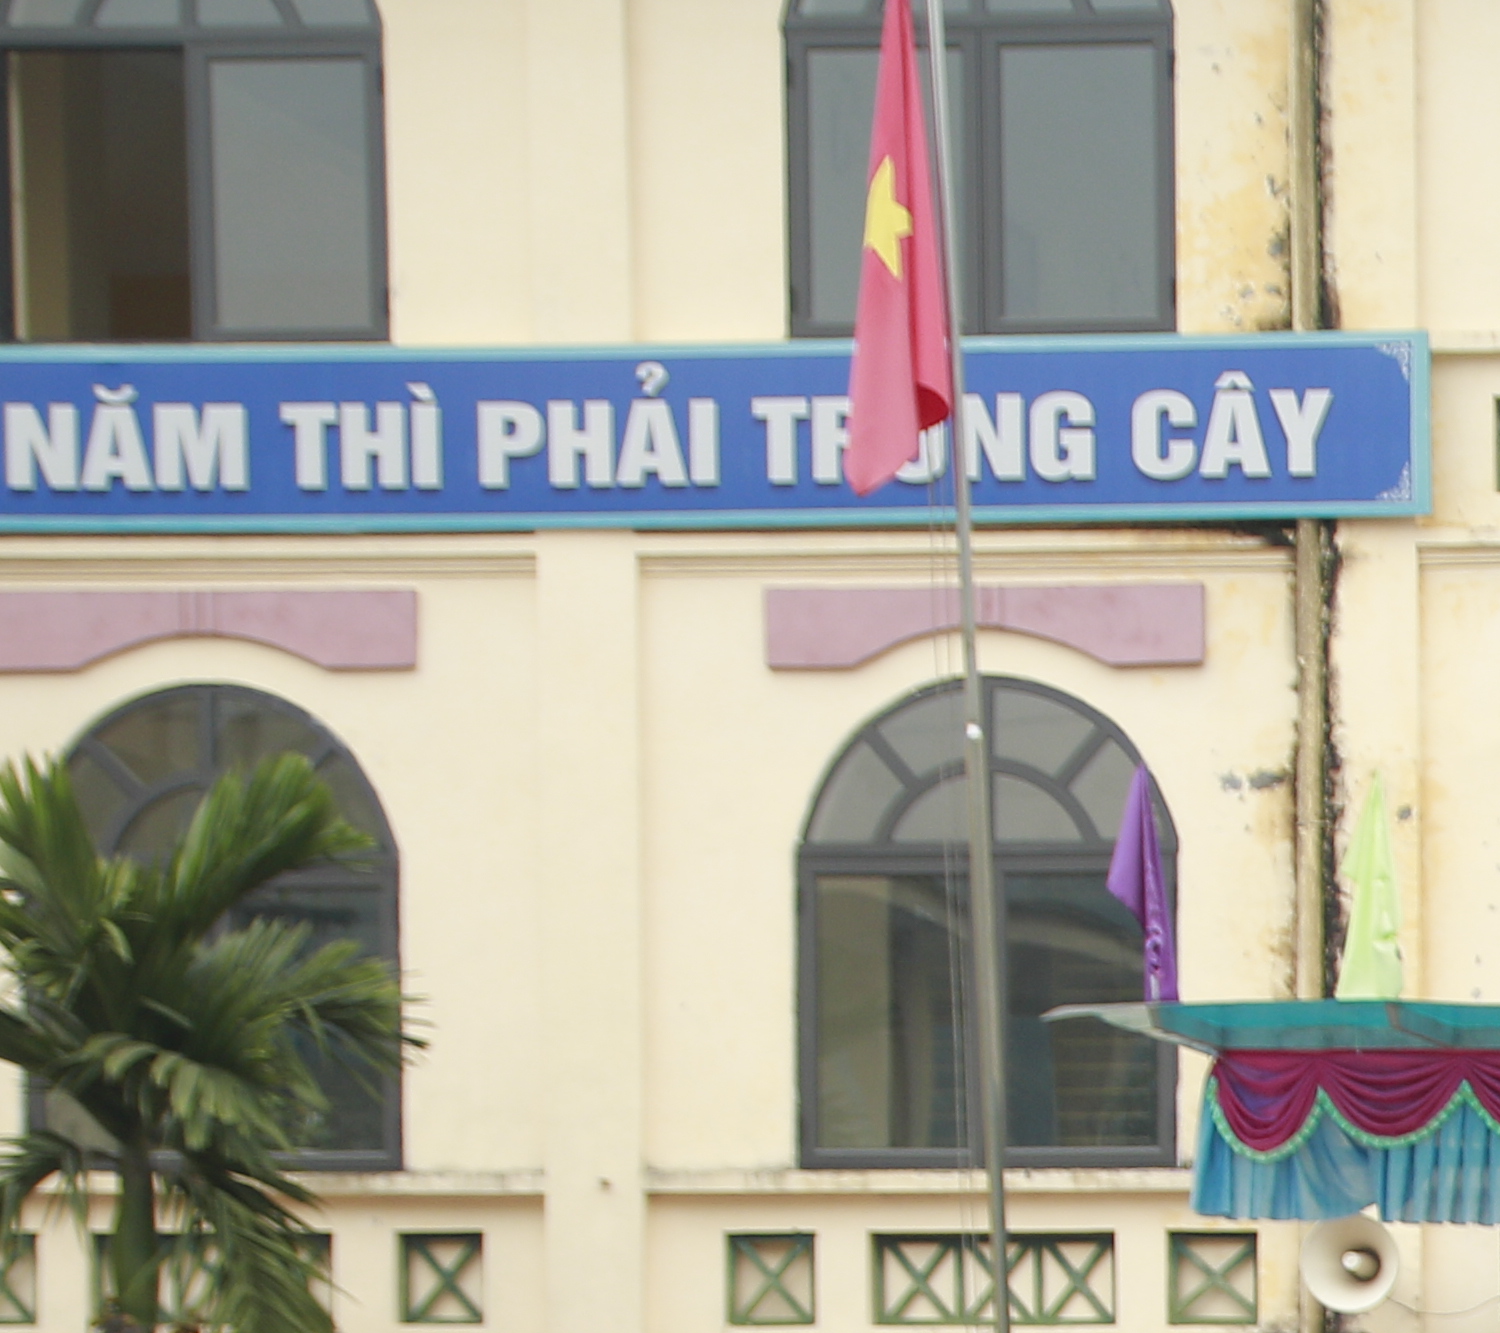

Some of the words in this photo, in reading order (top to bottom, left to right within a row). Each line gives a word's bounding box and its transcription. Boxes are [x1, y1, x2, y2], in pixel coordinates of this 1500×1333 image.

[5, 383, 250, 491] NĂM
[279, 382, 444, 491] THÌ
[477, 361, 721, 489] PHẢI
[1130, 369, 1335, 479] CÂY
